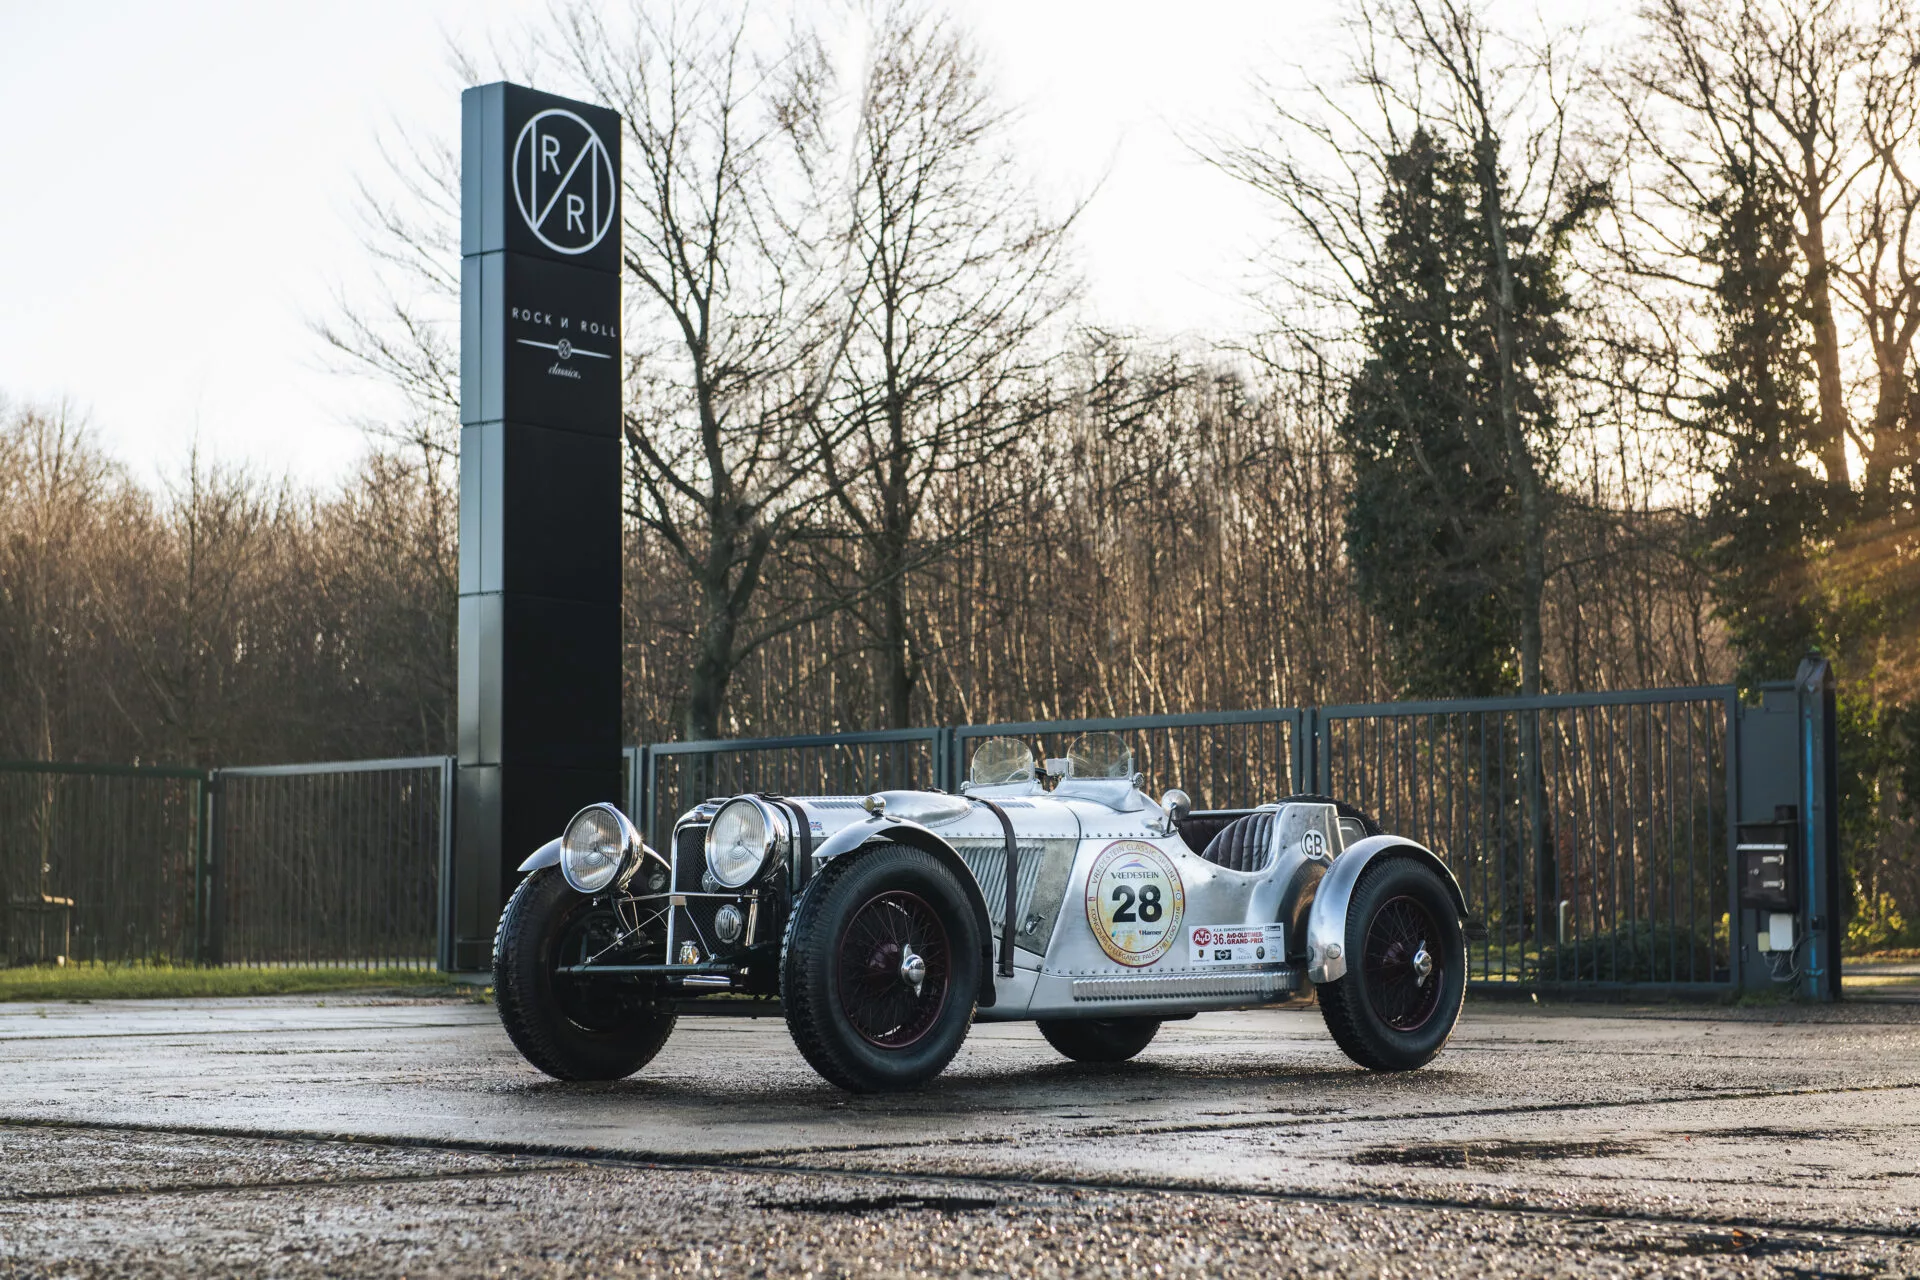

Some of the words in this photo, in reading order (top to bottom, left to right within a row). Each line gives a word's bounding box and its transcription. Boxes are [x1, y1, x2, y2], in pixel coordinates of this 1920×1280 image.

[512, 307, 552, 326] ROCK
[580, 320, 617, 338] ROLL
[1304, 833, 1323, 857] GB
[1092, 844, 1125, 884] VREDESTEIN
[1126, 843, 1157, 858] CLASSIC
[1110, 871, 1160, 880] VREDESTEIN
[1111, 884, 1163, 923] 28
[1090, 908, 1108, 947] CONCOURS
[1213, 933, 1227, 945] 36.
[1226, 937, 1264, 945] GRAND-PRIX
